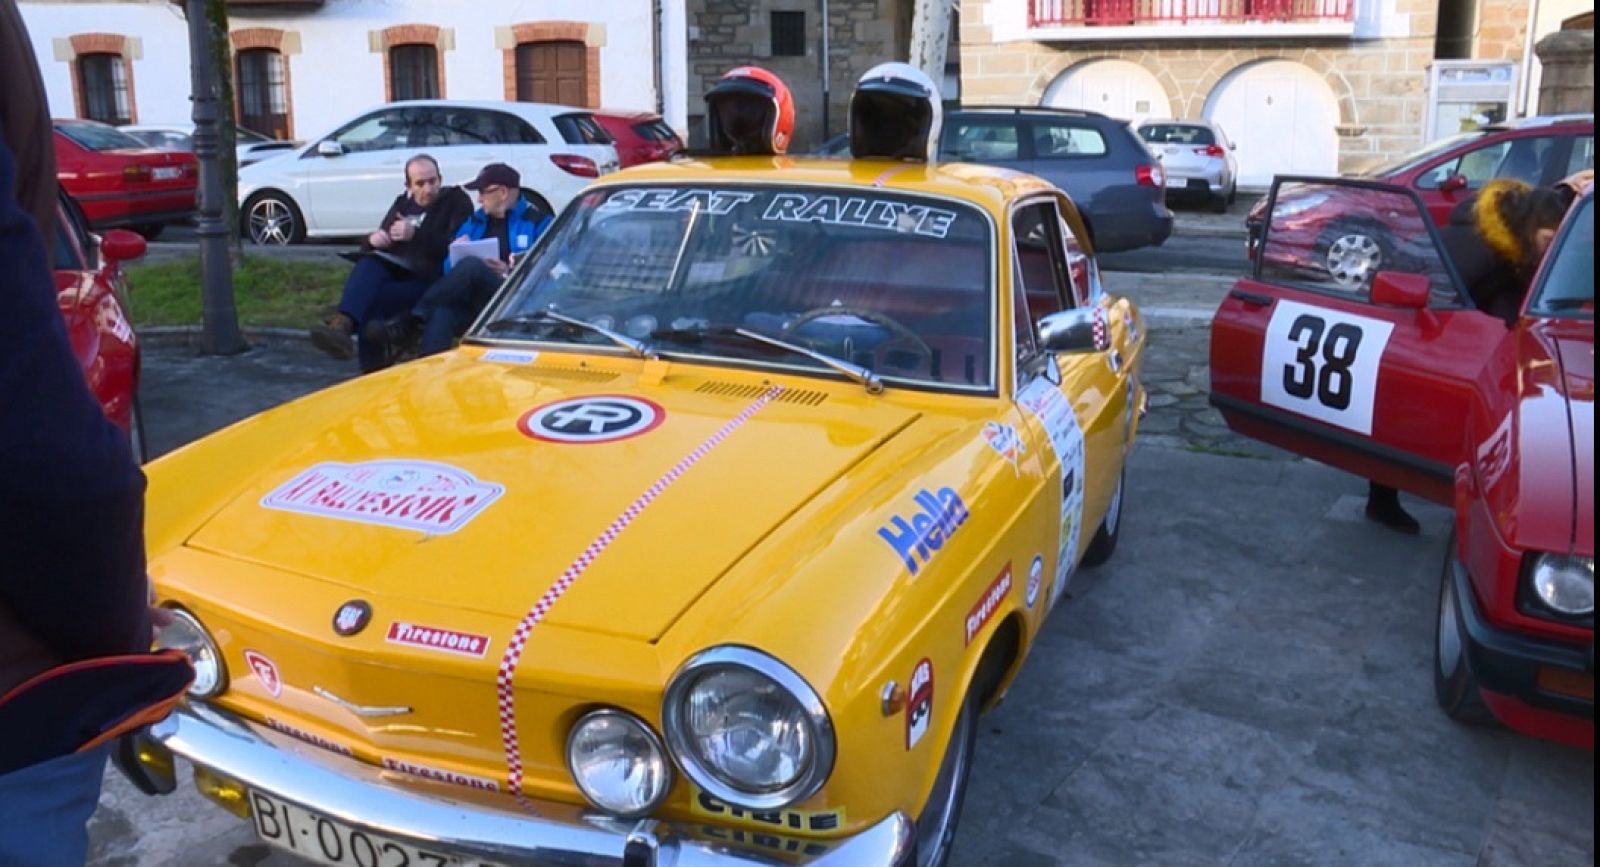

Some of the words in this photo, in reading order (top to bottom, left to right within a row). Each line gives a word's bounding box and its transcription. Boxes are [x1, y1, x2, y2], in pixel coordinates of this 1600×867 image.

[604, 188, 753, 215] SEAT
[763, 193, 956, 238] RALLYE
[1283, 314, 1363, 411] 38
[877, 486, 970, 577] Hella
[395, 622, 481, 652] Firestone
[966, 572, 1012, 643] Firestone
[384, 757, 499, 793] Firestone
